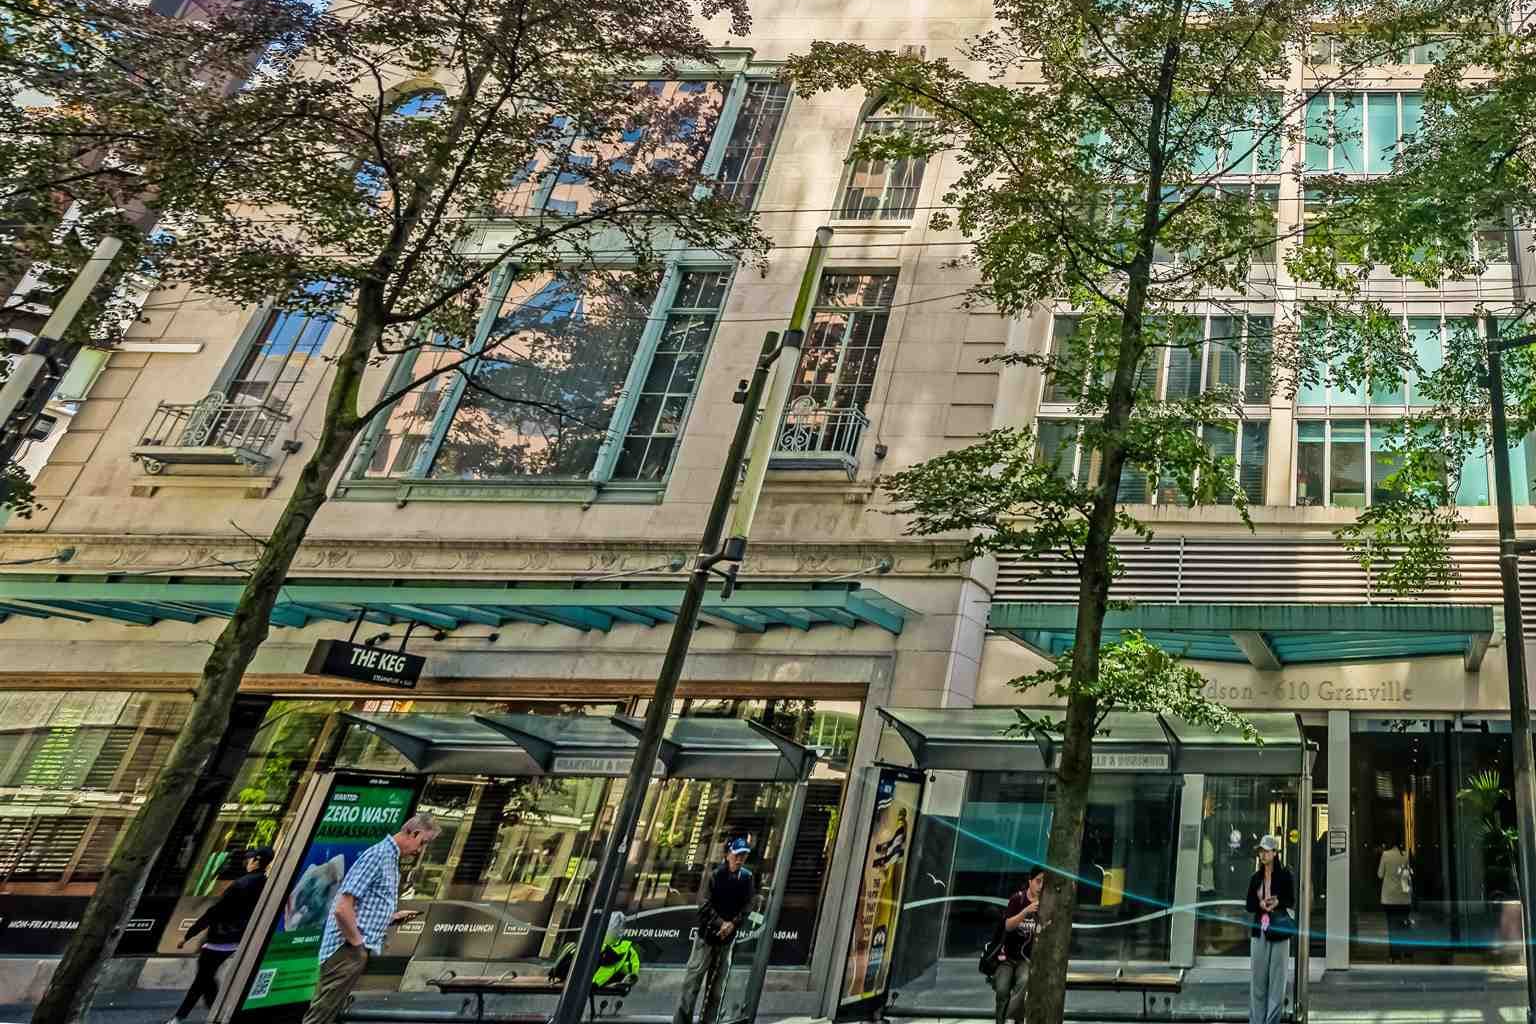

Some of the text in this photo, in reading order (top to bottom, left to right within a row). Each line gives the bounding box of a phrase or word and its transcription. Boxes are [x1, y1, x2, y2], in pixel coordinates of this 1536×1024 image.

[350, 647, 407, 673] THE KEG
[1273, 681, 1313, 701] 610
[1317, 679, 1414, 703] Granville
[322, 805, 361, 823] ZERO
[361, 806, 401, 824] WASTE
[433, 922, 494, 933] OPEN FOR LUNCH
[623, 928, 680, 938] PEN FOR LUNCH
